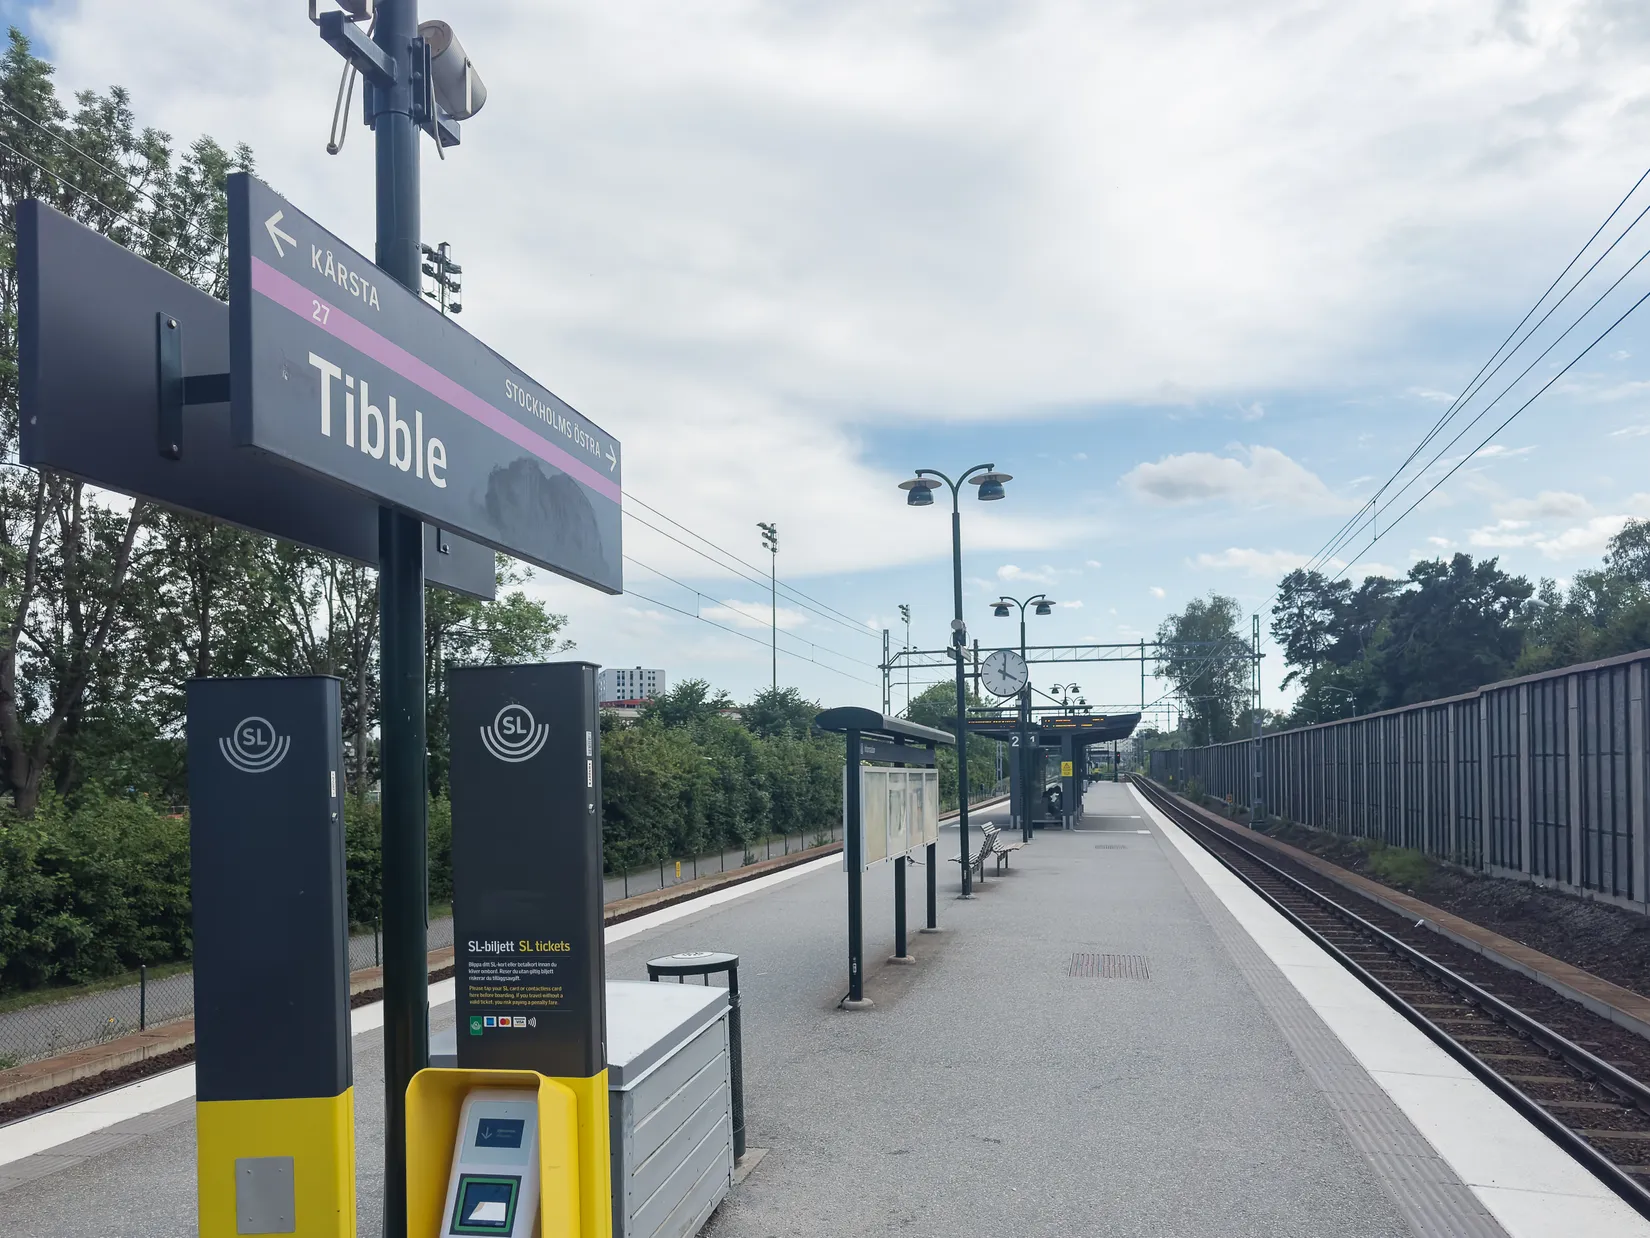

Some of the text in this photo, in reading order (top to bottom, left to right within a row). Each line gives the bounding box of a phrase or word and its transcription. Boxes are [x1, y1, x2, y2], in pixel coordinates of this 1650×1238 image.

[310, 243, 381, 312] KÅRSTA
[312, 299, 331, 325] 27
[308, 351, 448, 489] Tibble
[505, 379, 601, 459] STOCKHOLMS ÖSTRA
[503, 716, 527, 735] SL
[242, 728, 267, 747] SL
[1011, 735, 1020, 747] 2
[468, 940, 571, 954] SL-biljett SL tickets
